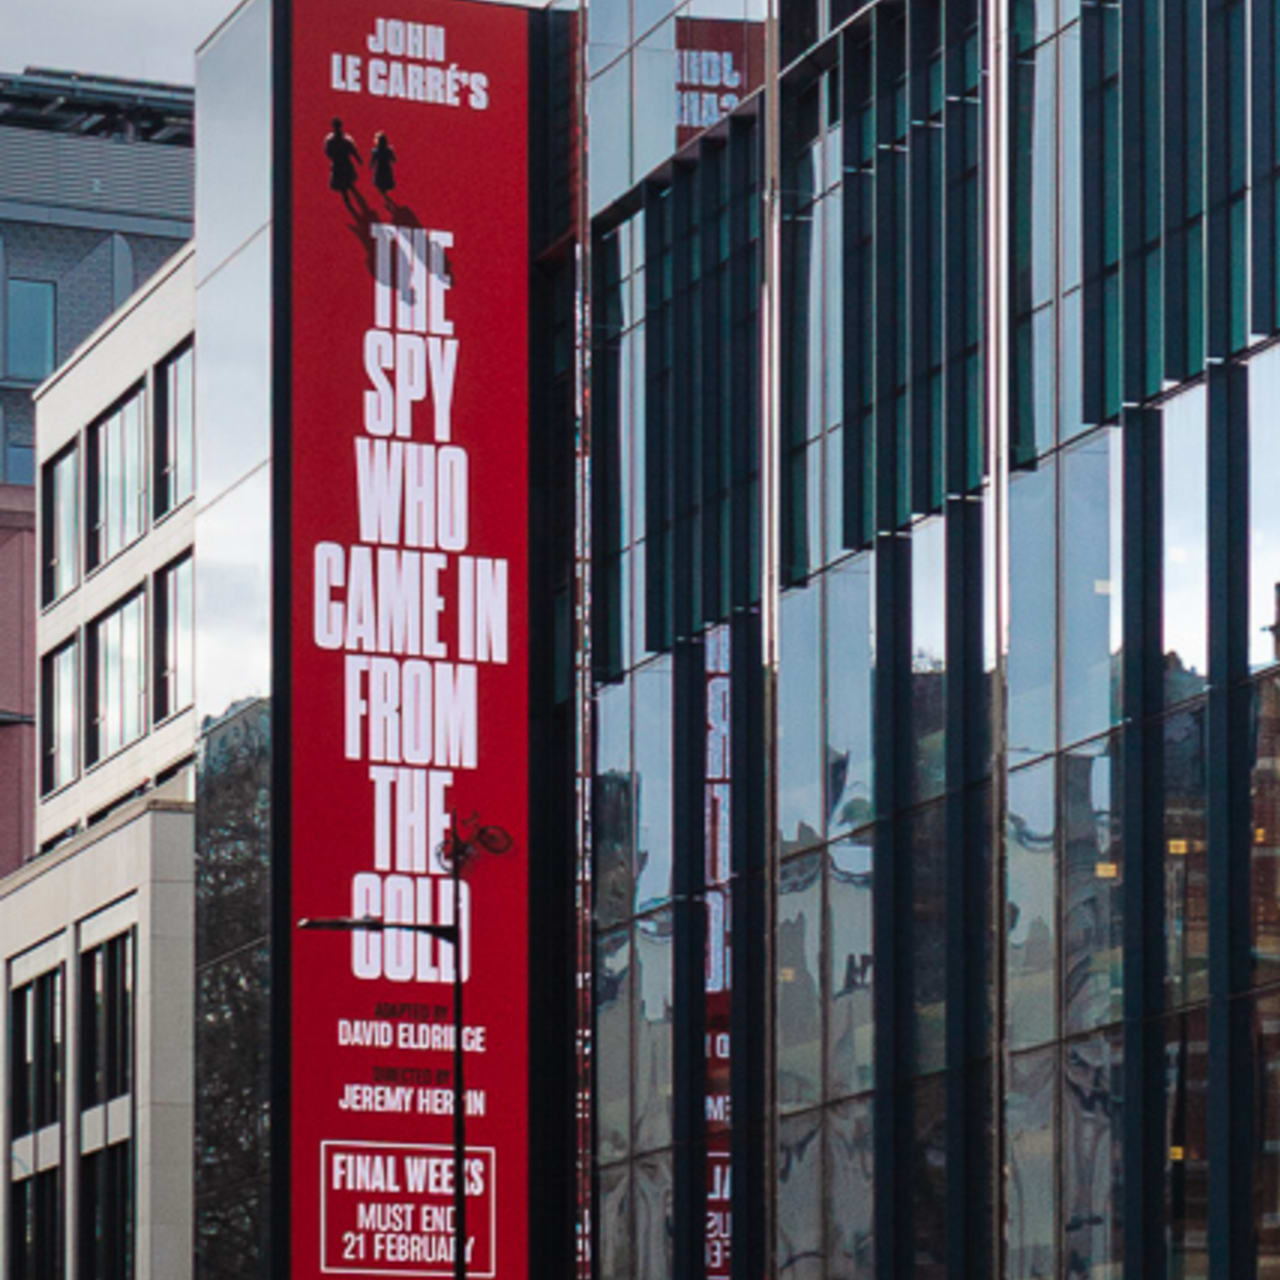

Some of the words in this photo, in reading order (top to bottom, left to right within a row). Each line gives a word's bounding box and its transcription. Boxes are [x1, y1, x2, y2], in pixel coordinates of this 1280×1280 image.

[367, 17, 446, 62] JOHN
[330, 53, 361, 93] LE
[367, 58, 489, 110] CARRÉ'S
[370, 222, 455, 335] THE
[363, 329, 459, 443] SPY
[354, 436, 468, 552] WHO
[314, 541, 447, 659] CAME
[458, 554, 508, 664] IN
[345, 654, 478, 770] FROM
[369, 765, 454, 874] THE
[352, 871, 470, 984] COLD
[338, 1019, 393, 1047] DAVID
[338, 1084, 415, 1113] JEREMY
[417, 1087, 486, 1117] HERIN
[332, 1153, 400, 1192] FINAL
[342, 1231, 366, 1260] 21
[357, 1203, 415, 1232] MUST
